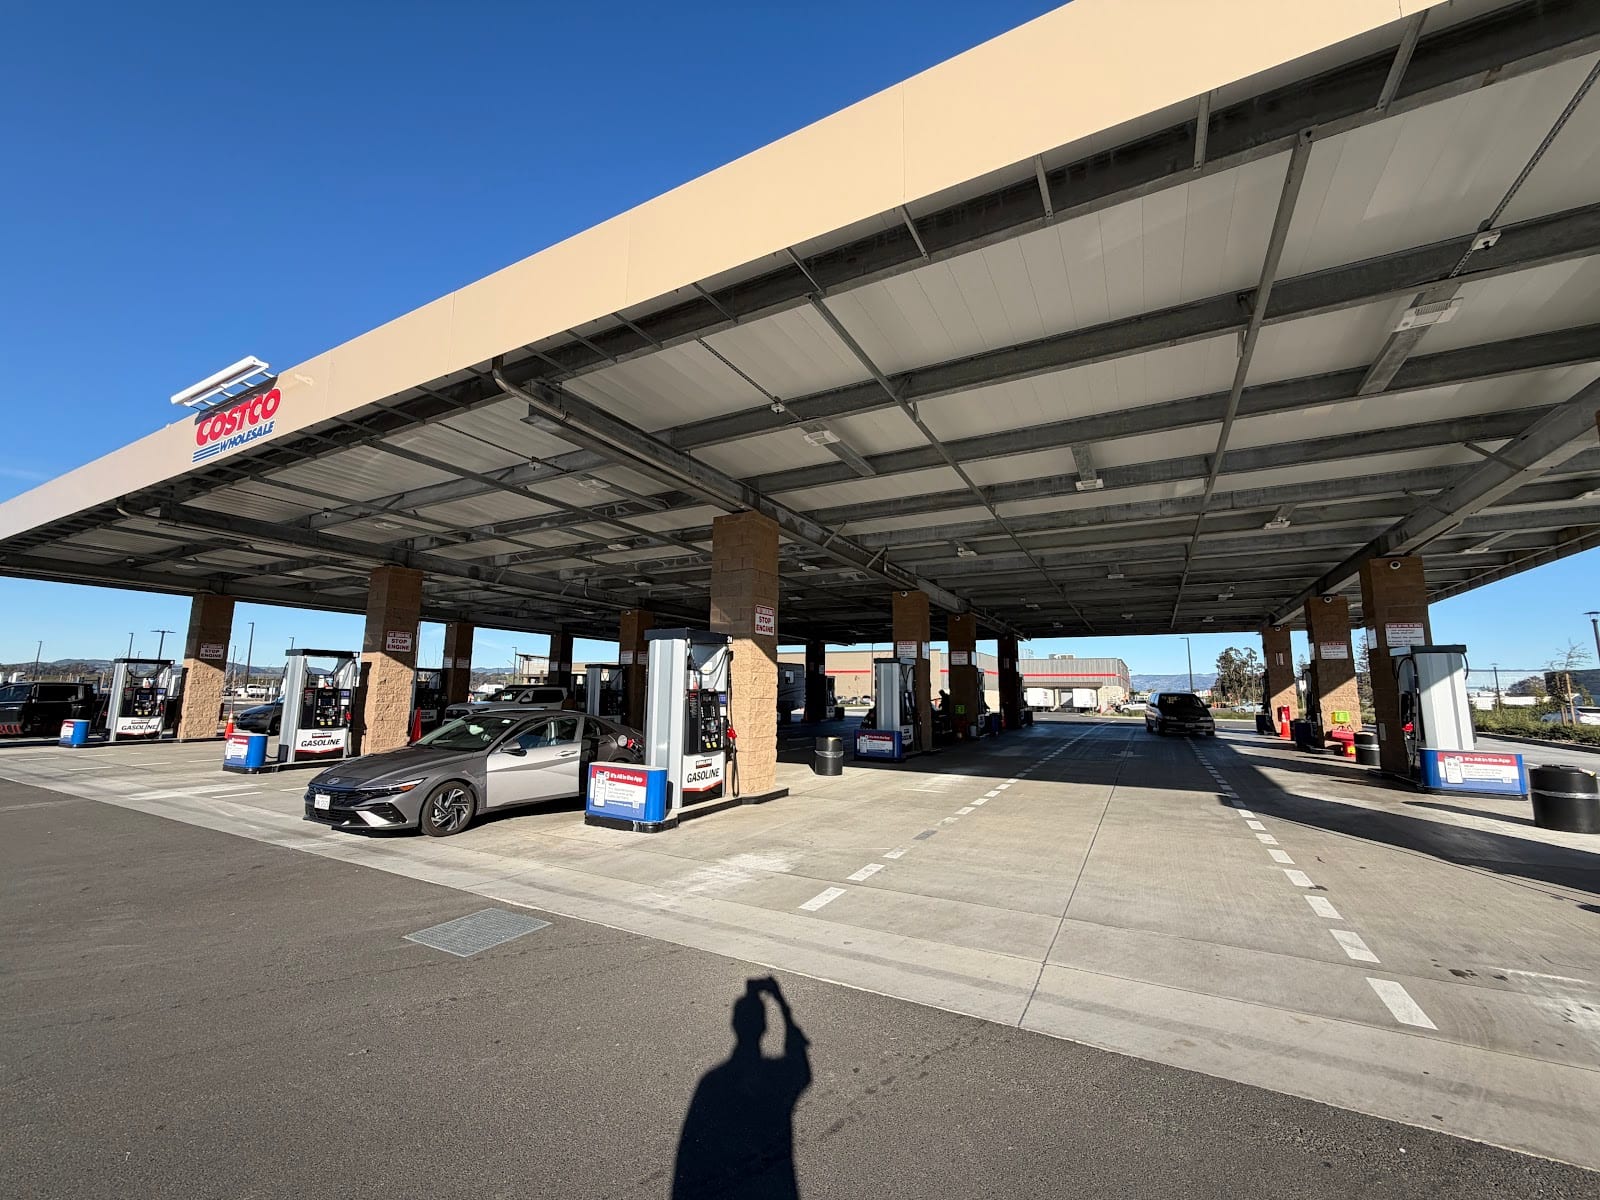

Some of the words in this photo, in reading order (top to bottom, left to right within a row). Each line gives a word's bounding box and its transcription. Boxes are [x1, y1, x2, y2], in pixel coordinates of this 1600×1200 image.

[196, 389, 281, 446] COSTCO
[219, 420, 274, 452] WHOLESALE
[759, 616, 772, 624] STOP
[756, 624, 774, 633] ENGINE
[301, 738, 342, 747] GASOLINE
[687, 767, 720, 783] GASOLINE
